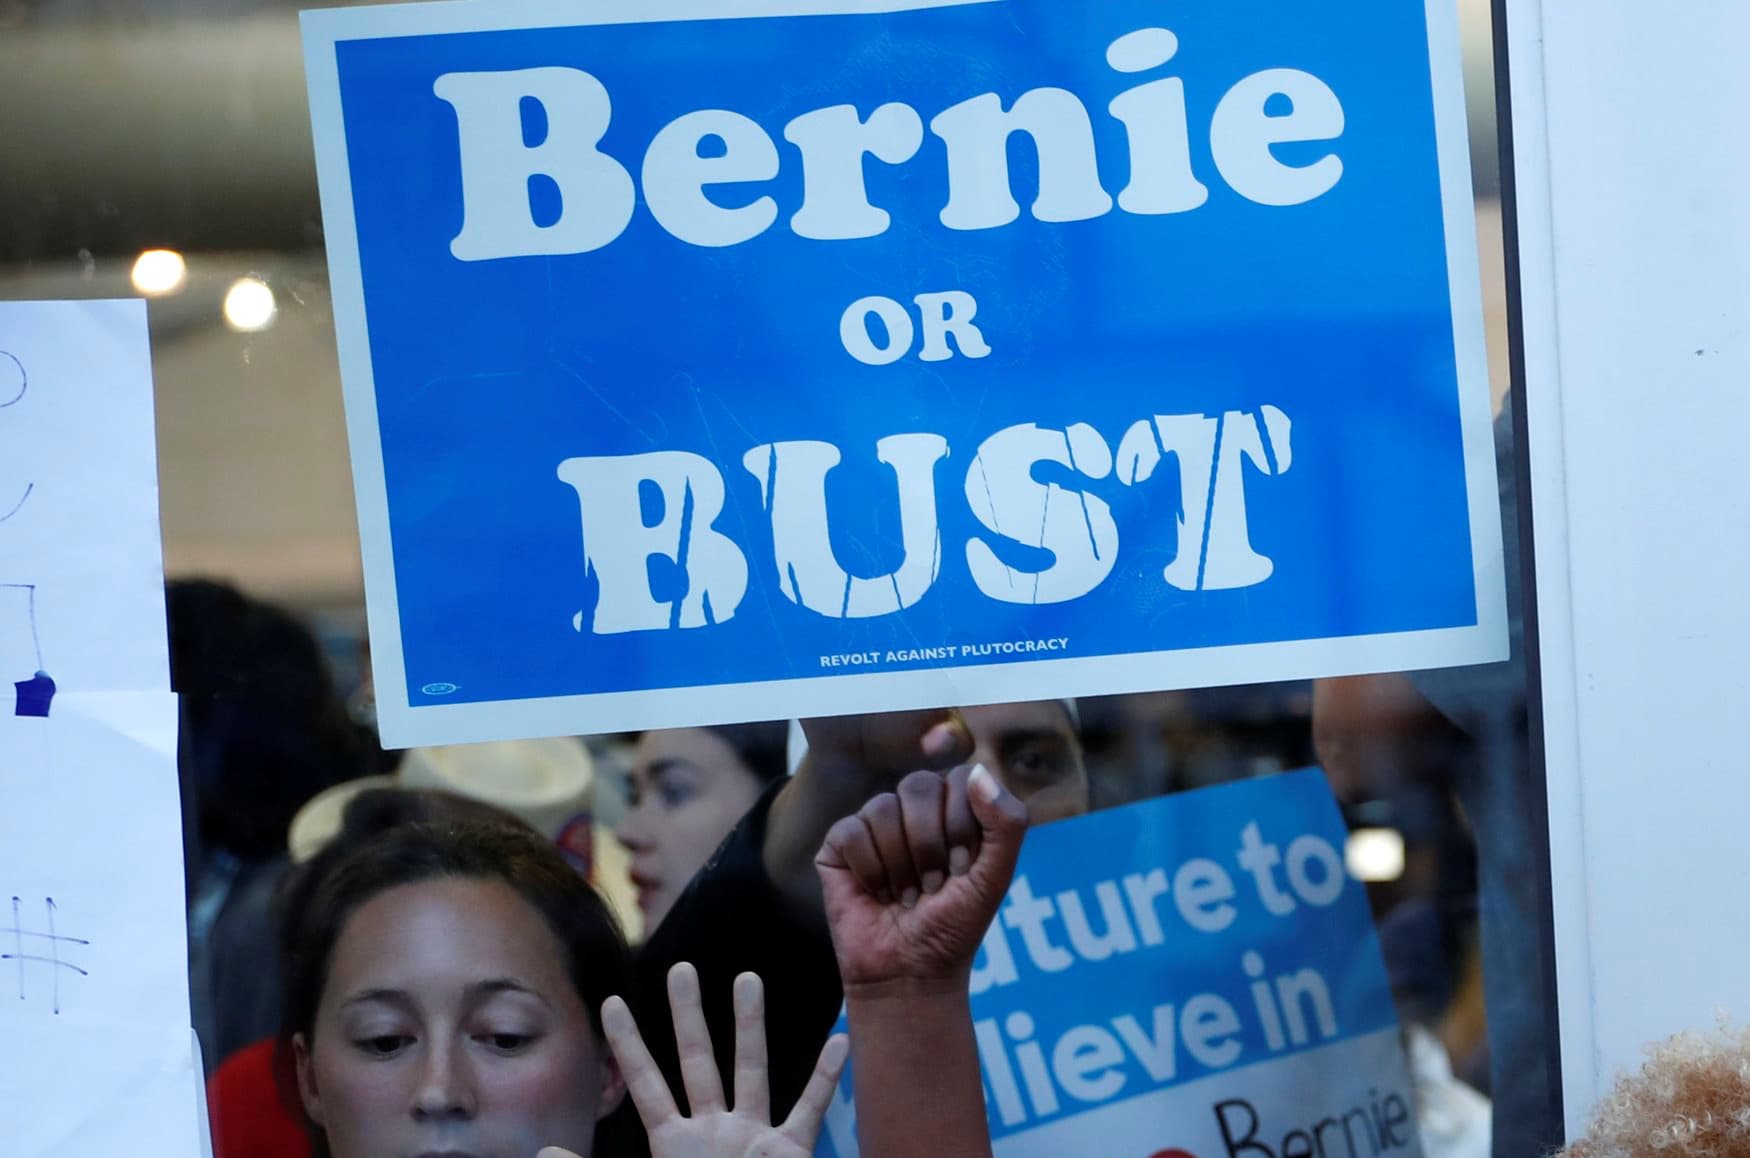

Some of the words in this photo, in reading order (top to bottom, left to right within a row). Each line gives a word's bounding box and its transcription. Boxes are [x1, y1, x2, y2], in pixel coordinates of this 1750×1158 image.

[433, 27, 1345, 262] Bernie
[839, 290, 992, 366] OR
[557, 405, 1292, 634] BUST
[820, 650, 881, 668] REVOLT
[885, 645, 958, 664] AGAINST
[962, 637, 1070, 659] PLUTOCRACY
[969, 857, 1238, 996] uture
[1236, 822, 1343, 914] to
[1242, 951, 1340, 1052] in
